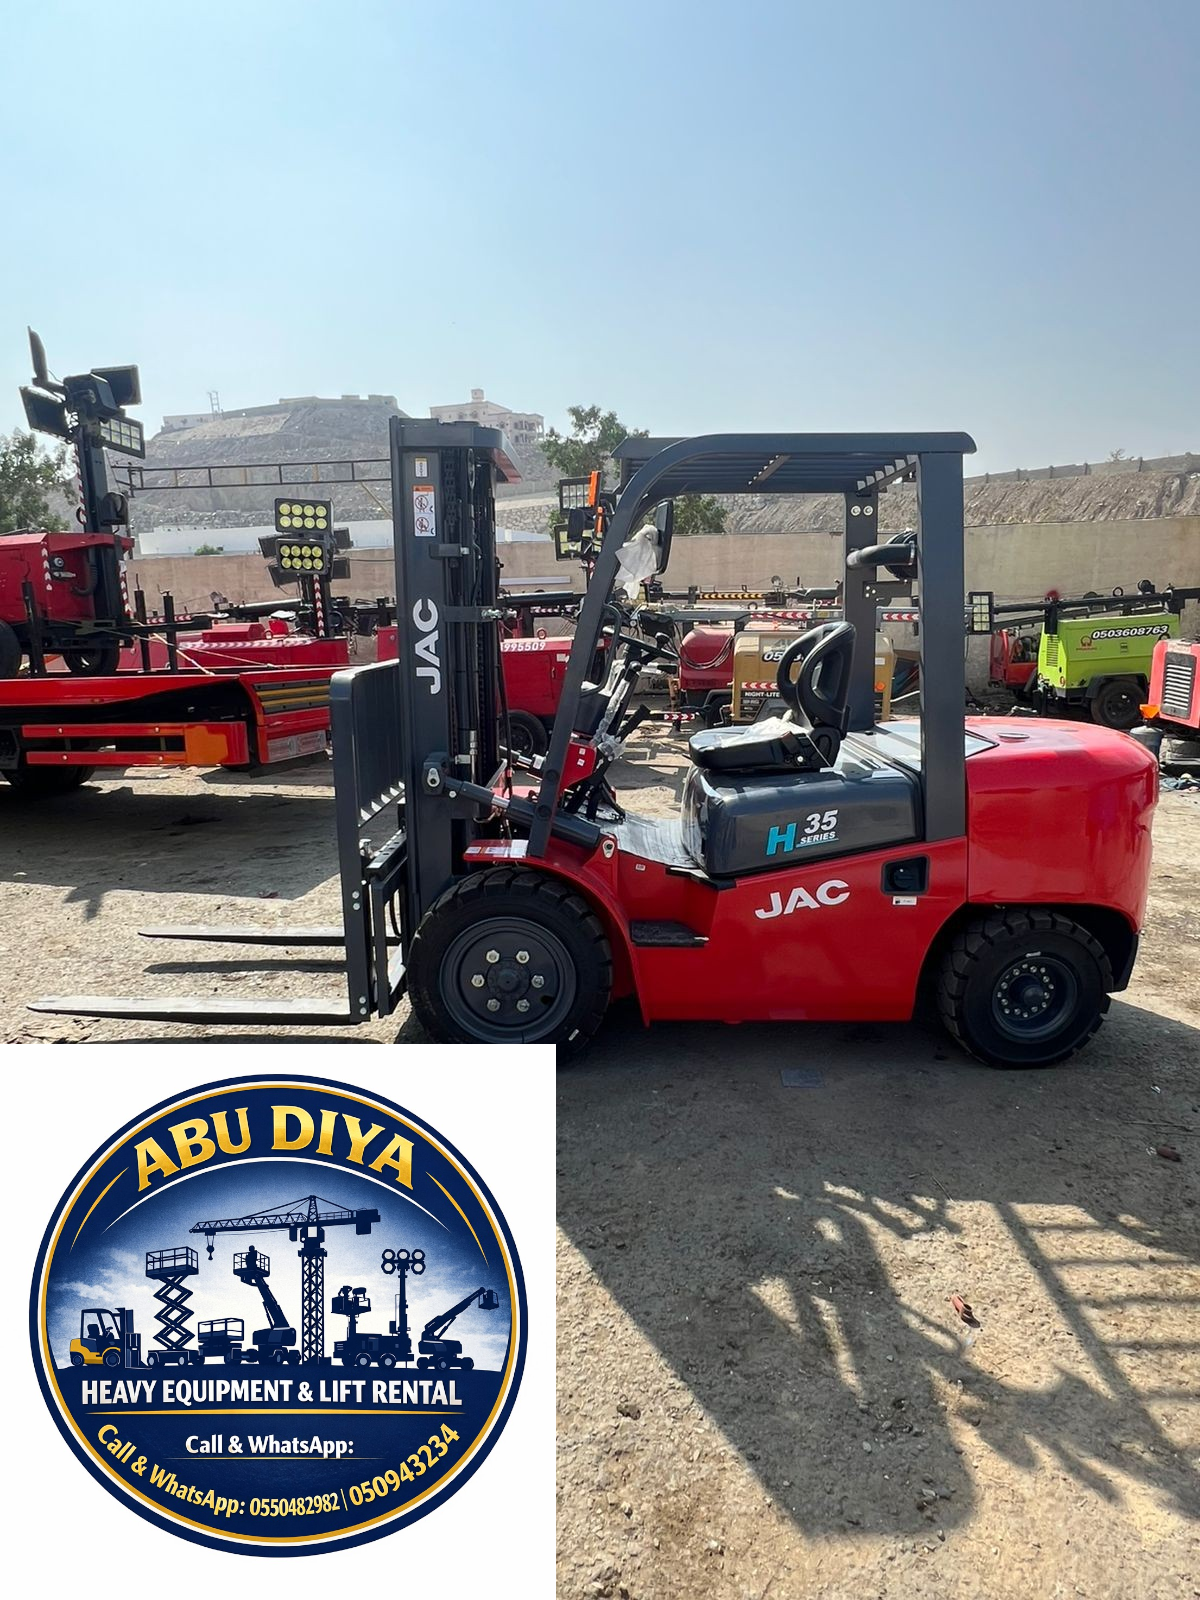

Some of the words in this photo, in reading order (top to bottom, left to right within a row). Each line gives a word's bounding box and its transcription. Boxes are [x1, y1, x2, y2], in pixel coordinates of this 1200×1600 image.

[412, 598, 441, 695] JAC
[1092, 625, 1169, 640] 0503608763
[804, 809, 839, 834] 35
[766, 822, 798, 856] H
[800, 831, 836, 845] SERIES
[754, 879, 851, 919] JAC
